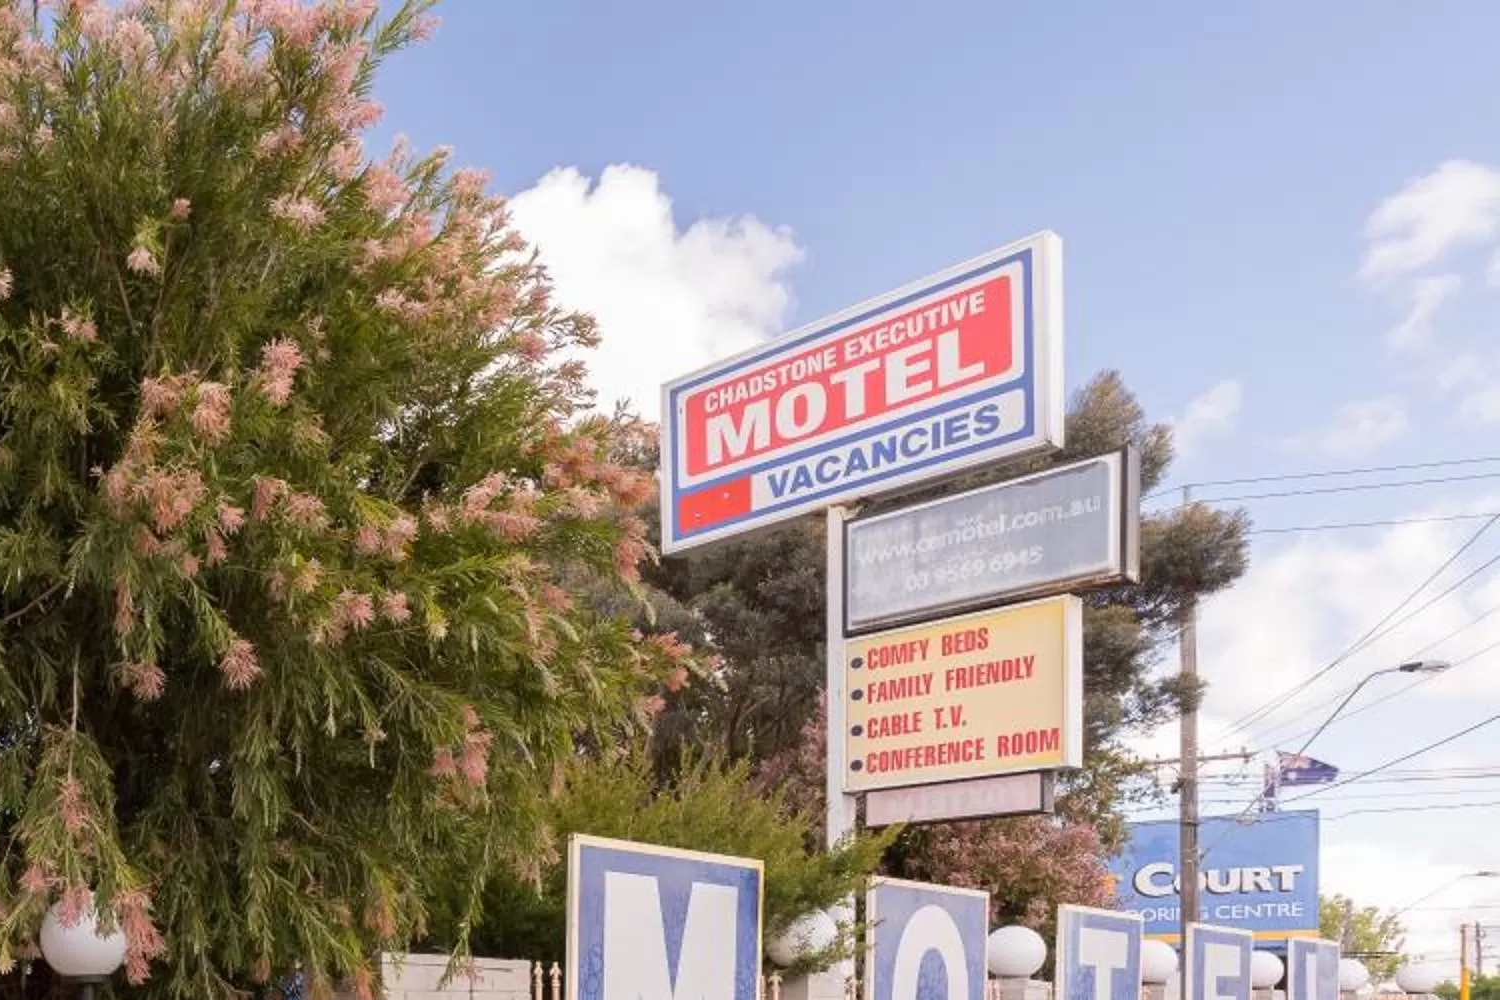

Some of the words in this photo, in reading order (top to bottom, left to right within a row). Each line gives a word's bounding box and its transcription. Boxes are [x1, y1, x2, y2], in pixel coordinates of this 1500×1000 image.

[704, 346, 836, 412] CHADSTONE
[844, 291, 986, 359] EXECUTIVE
[705, 328, 986, 466] MOTEL
[767, 403, 1001, 499] VACANCIES
[867, 638, 930, 670] COMFY
[941, 627, 989, 657] BEDS
[867, 672, 933, 704] FAMILY
[945, 655, 1035, 691] FRIENDLY
[867, 711, 923, 739] CABLE
[933, 705, 967, 730] T.V.
[866, 738, 985, 774] CONFERENCE
[997, 727, 1061, 758] ROOM
[1215, 902, 1305, 920] CENTRE
